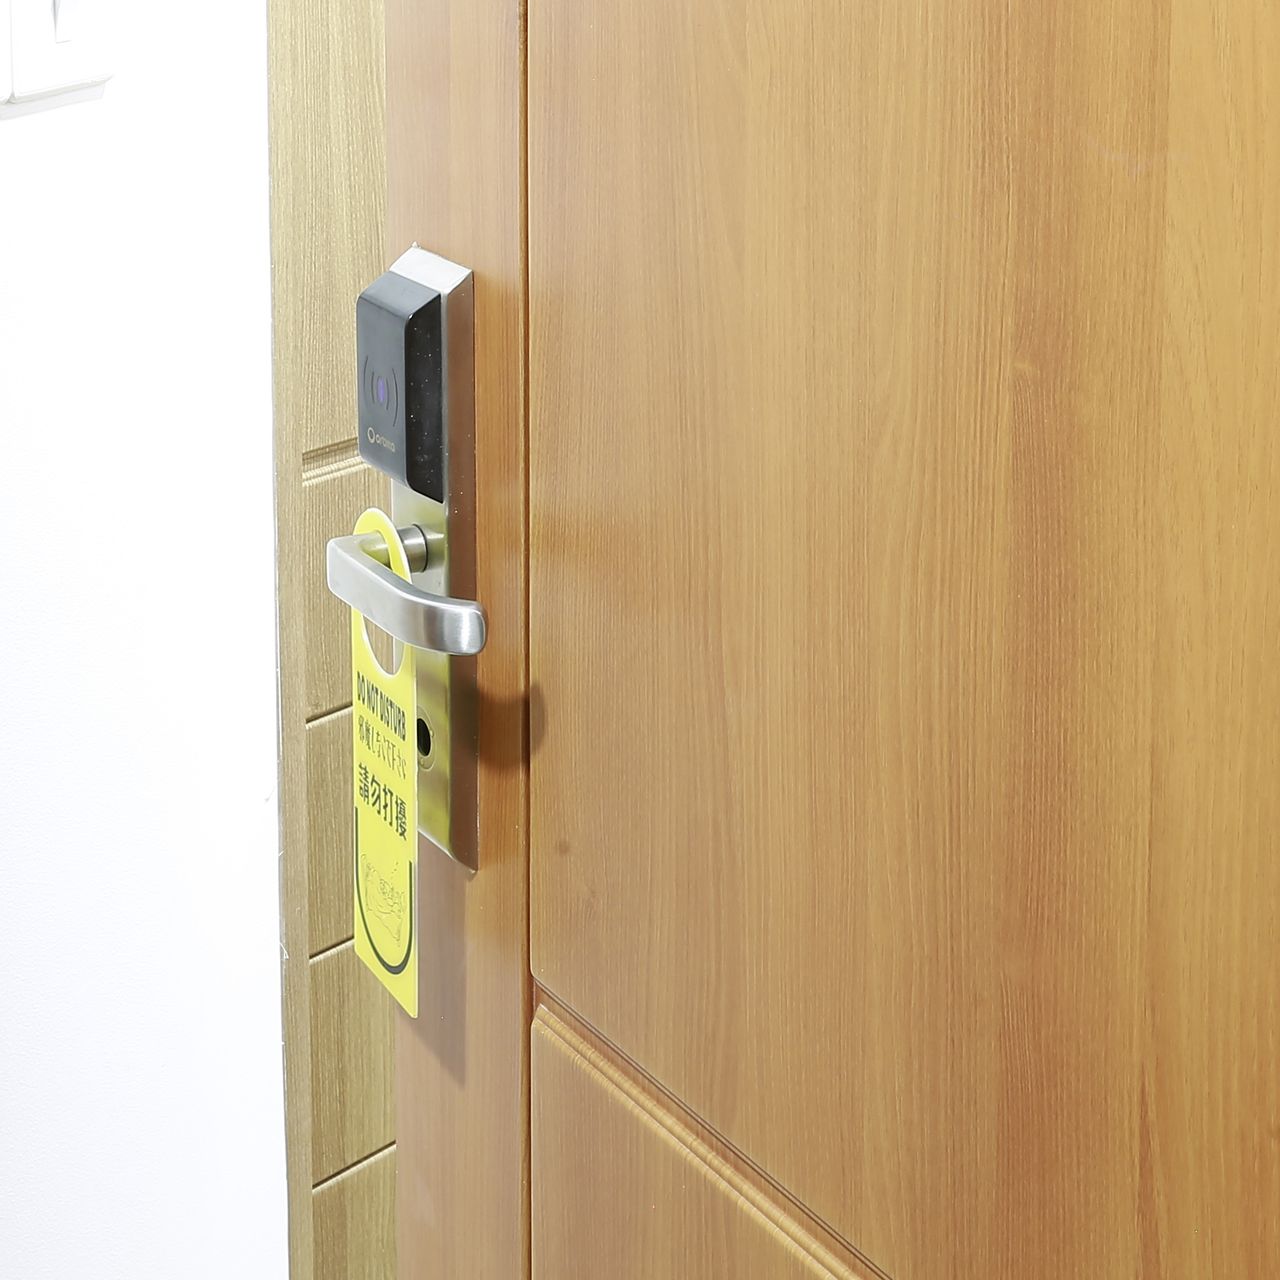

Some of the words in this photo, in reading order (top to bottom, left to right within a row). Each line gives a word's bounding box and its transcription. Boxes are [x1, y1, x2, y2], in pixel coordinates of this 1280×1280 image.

[357, 670, 366, 705] DO
[366, 679, 379, 718] NOT
[379, 690, 406, 742] DISTURB
[358, 762, 407, 841] 請勿打擾
